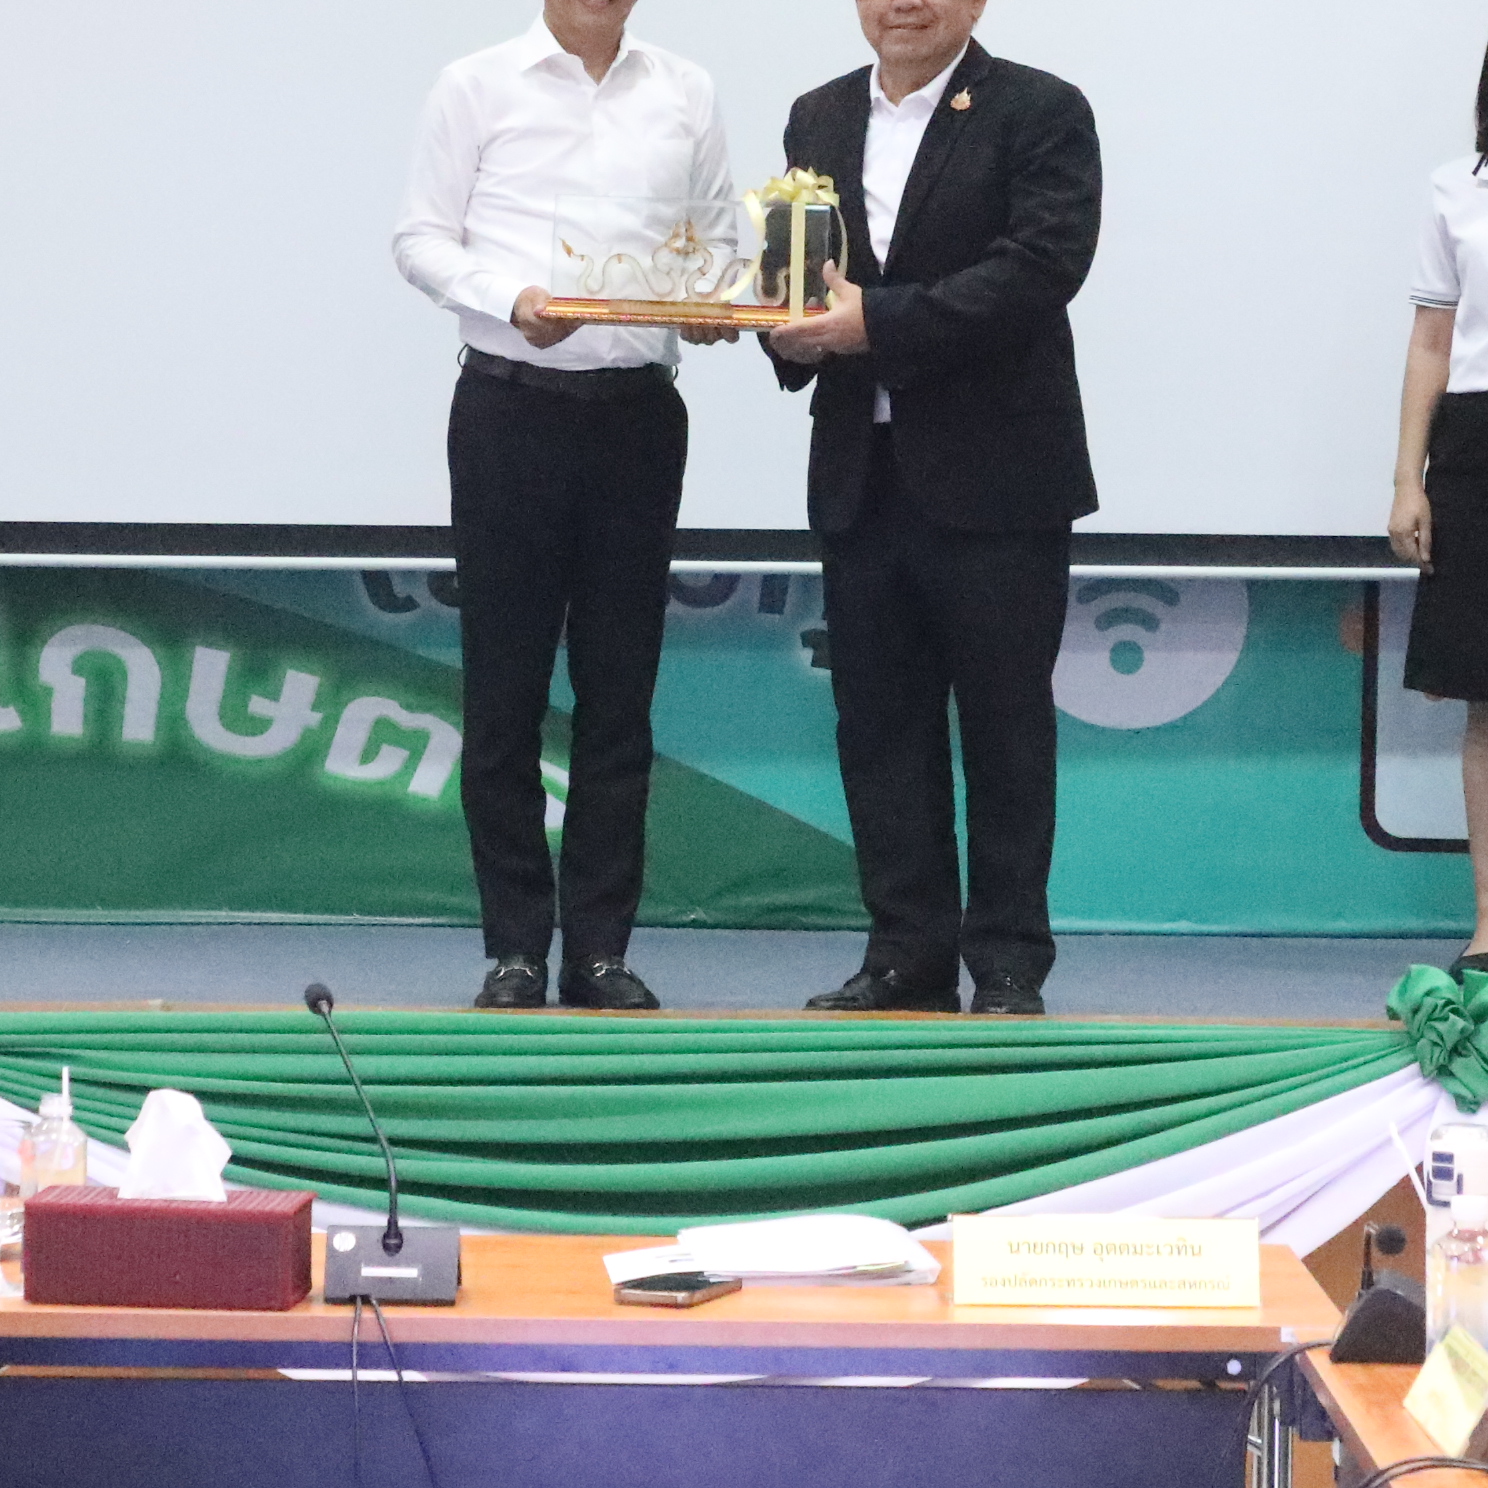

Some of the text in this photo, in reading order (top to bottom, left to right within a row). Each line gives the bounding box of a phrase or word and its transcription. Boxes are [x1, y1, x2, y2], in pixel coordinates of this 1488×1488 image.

[1007, 1236, 1203, 1262] นายกฤษ อุตตมะเวทิน
